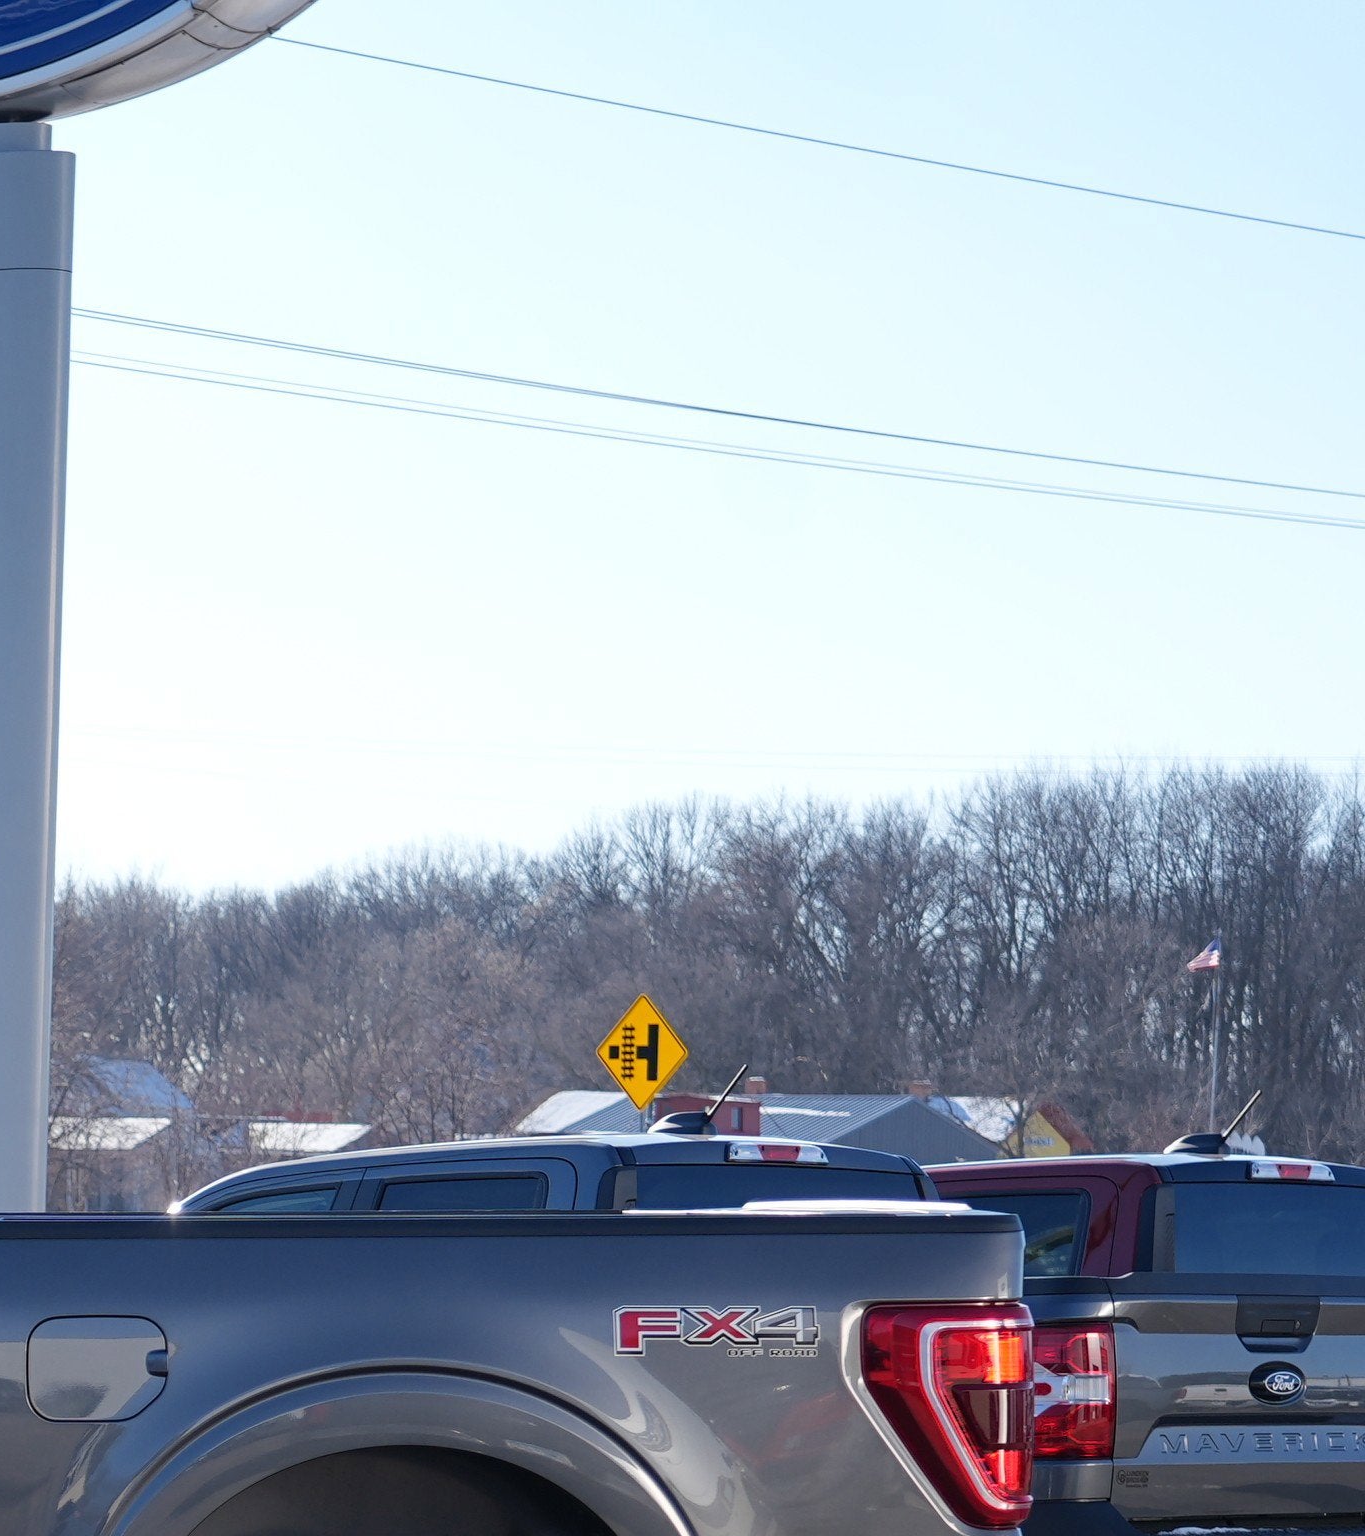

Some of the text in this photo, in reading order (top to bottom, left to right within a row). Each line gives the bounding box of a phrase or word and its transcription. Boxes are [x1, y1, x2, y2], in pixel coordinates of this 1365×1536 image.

[613, 1305, 820, 1357] FX4
[726, 1348, 819, 1358] OFF ROAD
